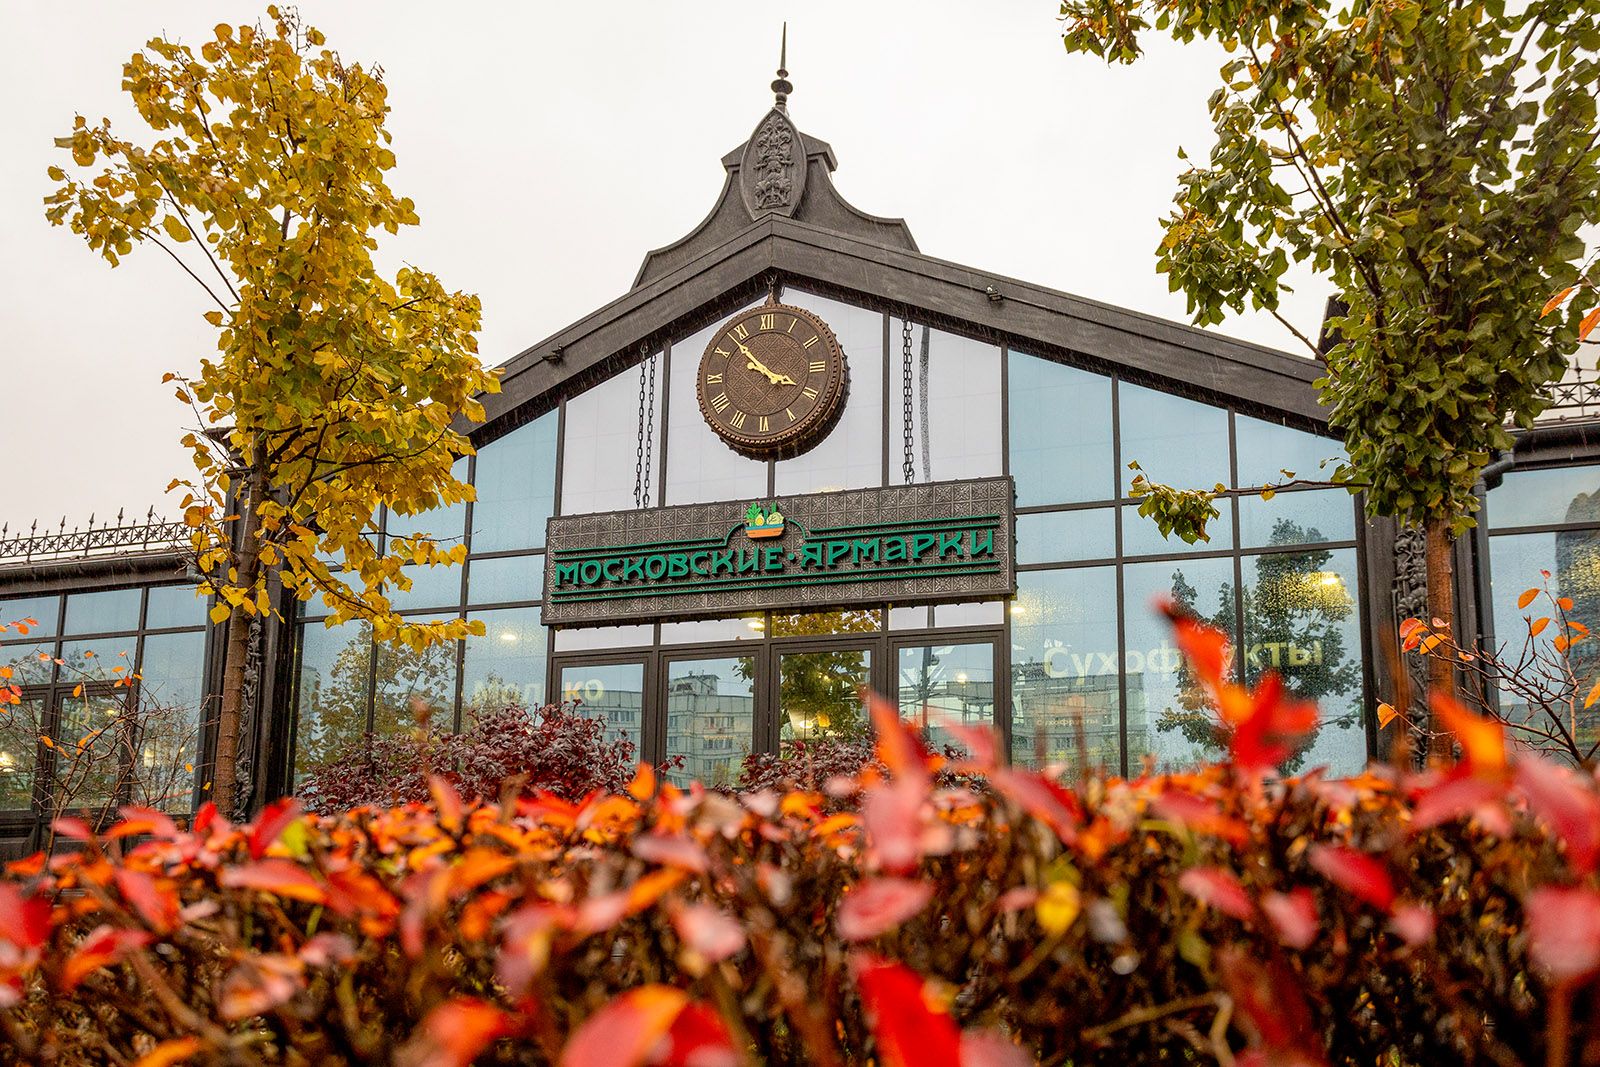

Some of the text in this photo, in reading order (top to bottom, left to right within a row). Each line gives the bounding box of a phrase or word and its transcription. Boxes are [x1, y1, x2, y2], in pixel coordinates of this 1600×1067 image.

[759, 313, 775, 330] XII
[733, 323, 749, 340] XI
[802, 335, 819, 349] II
[714, 346, 730, 358] X
[809, 361, 826, 373] III
[707, 373, 723, 385] IX
[710, 392, 731, 415] VIII
[729, 410, 747, 429] VII
[785, 408, 797, 422] V
[759, 416, 769, 432] VI
[554, 547, 784, 587] МОСКОВСКИЕ
[1043, 640, 1323, 685] Сухофкты
[472, 678, 606, 705] Молко
